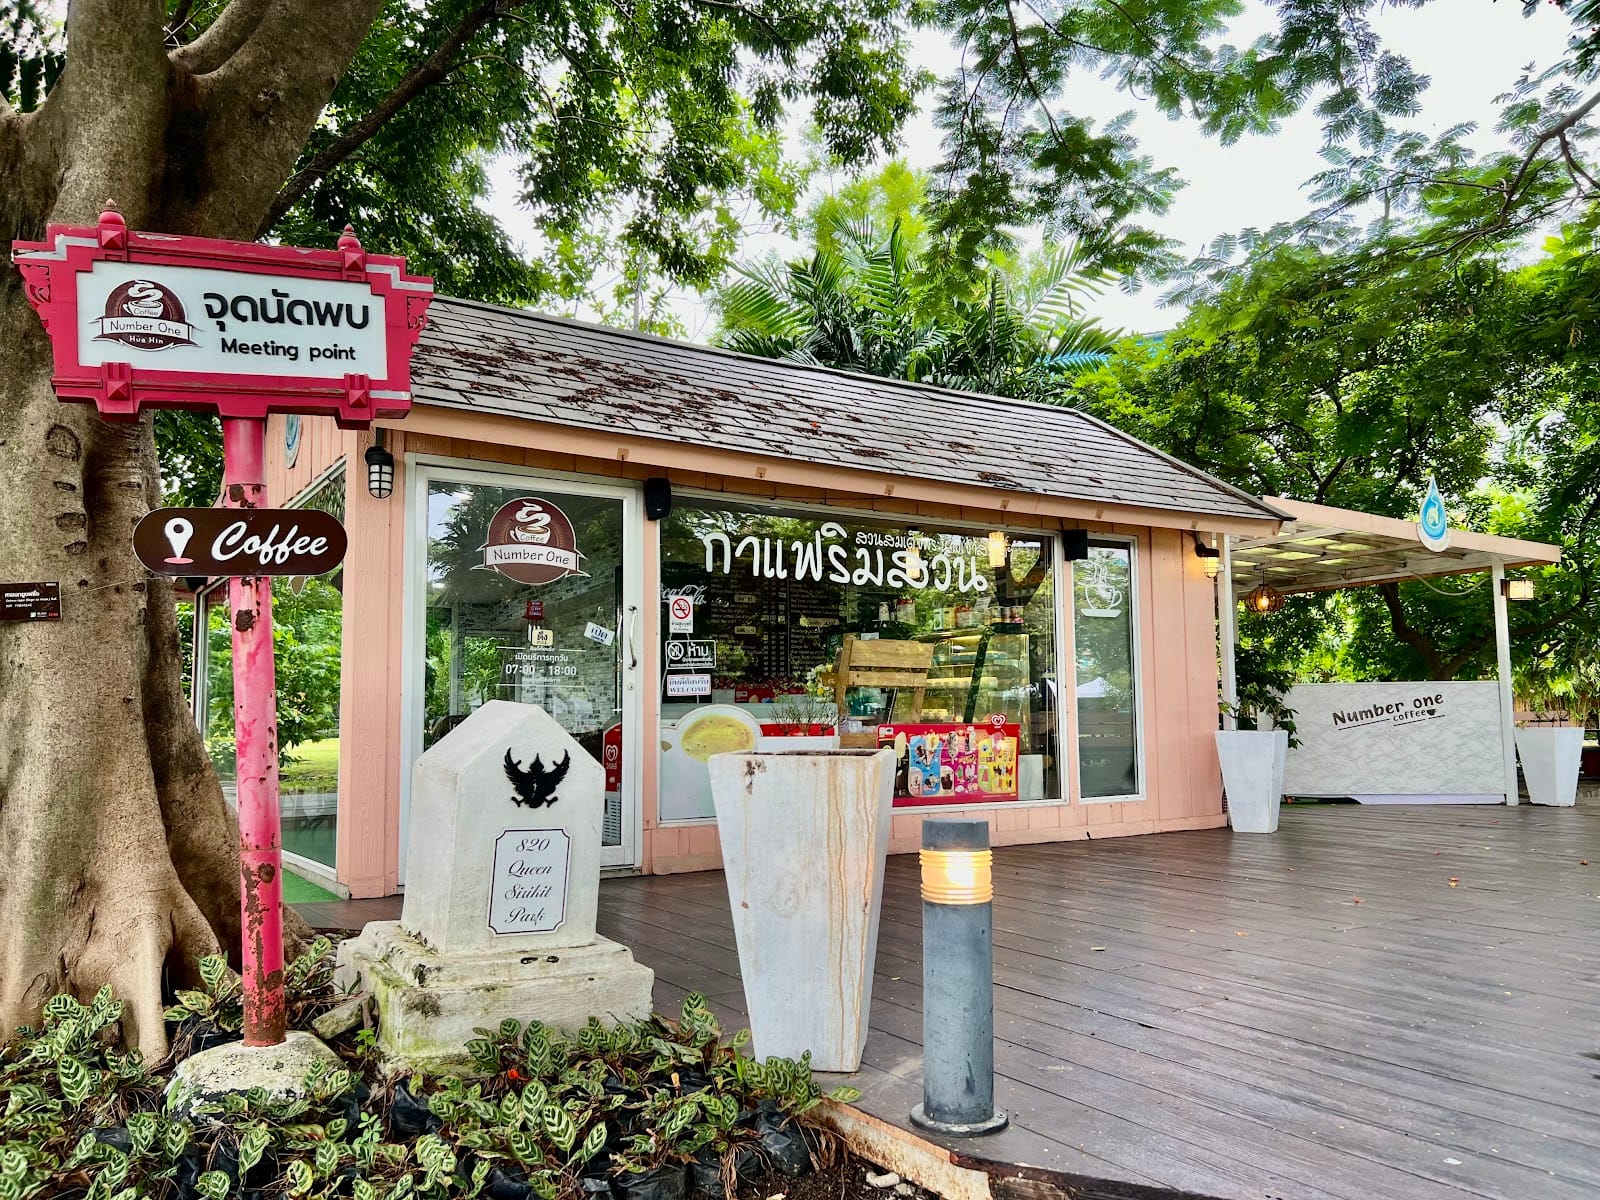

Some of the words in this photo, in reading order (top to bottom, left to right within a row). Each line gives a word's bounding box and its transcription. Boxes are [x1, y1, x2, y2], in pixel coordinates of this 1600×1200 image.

[134, 308, 159, 316] Coffee
[203, 289, 369, 332] จุดนัดพบ
[110, 320, 153, 331] Number
[158, 322, 181, 335] One
[149, 336, 164, 344] Hin
[221, 338, 298, 361] Meeting
[310, 344, 356, 361] point
[211, 521, 329, 566] Coffee
[520, 534, 545, 542] Coffee
[493, 548, 543, 560] Number
[546, 550, 570, 564] One
[703, 522, 988, 592] กาแฟริมสวน
[688, 641, 709, 657] ห้าม
[505, 664, 536, 674] 07:00
[548, 665, 577, 676] 18:00
[1332, 702, 1405, 726] Number
[1413, 694, 1444, 709] one
[516, 837, 551, 852] 820
[508, 860, 552, 878] Queen
[504, 884, 552, 899] Sirikit
